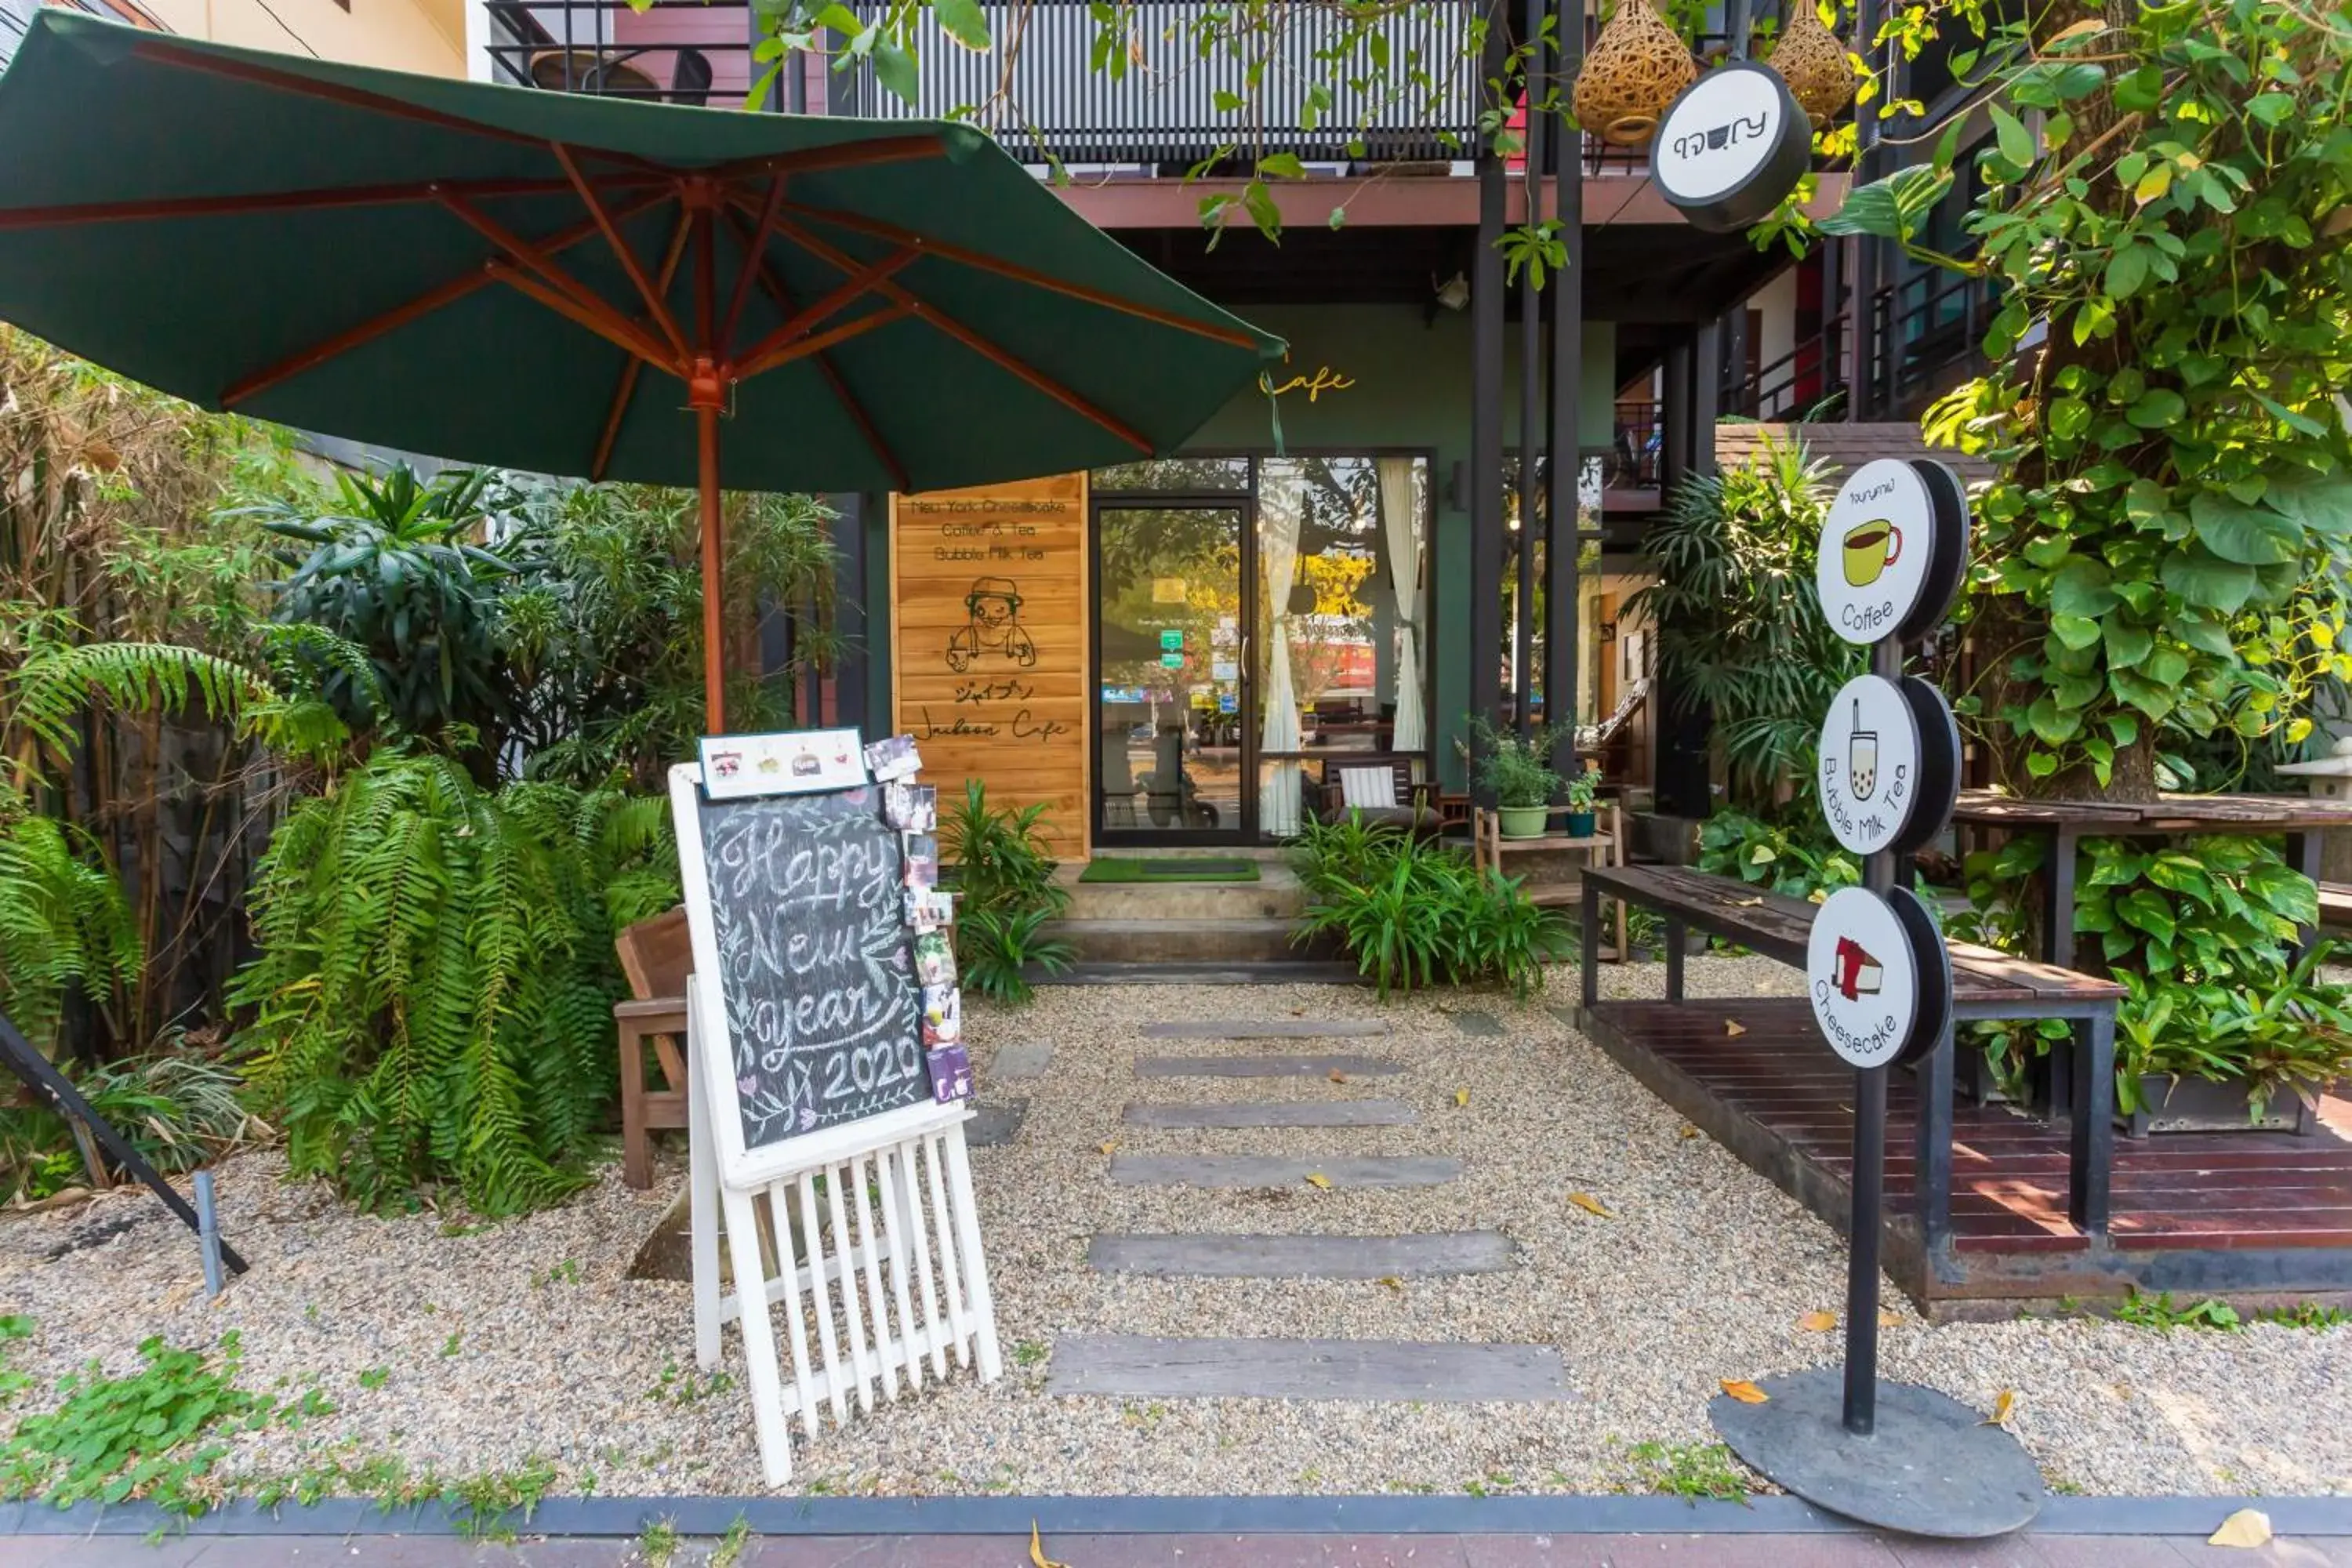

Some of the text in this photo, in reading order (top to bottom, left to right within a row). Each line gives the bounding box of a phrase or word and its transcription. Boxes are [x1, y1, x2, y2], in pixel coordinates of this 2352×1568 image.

[942, 523, 984, 537] Coffee
[1013, 523, 1036, 536] Tea
[946, 501, 975, 514] York
[982, 499, 1066, 514] Cheesecake
[934, 546, 985, 561] Bubble
[1021, 546, 1044, 561] Tea
[1842, 601, 1893, 631] Coffee
[1012, 709, 1070, 742] Cafe
[1824, 757, 1907, 841] Bubble Milk Tea
[721, 818, 893, 911] Happy
[735, 895, 862, 982] New
[749, 981, 892, 1072] year
[1815, 979, 1897, 1054] Cheesecake
[824, 1036, 921, 1099] 2020
